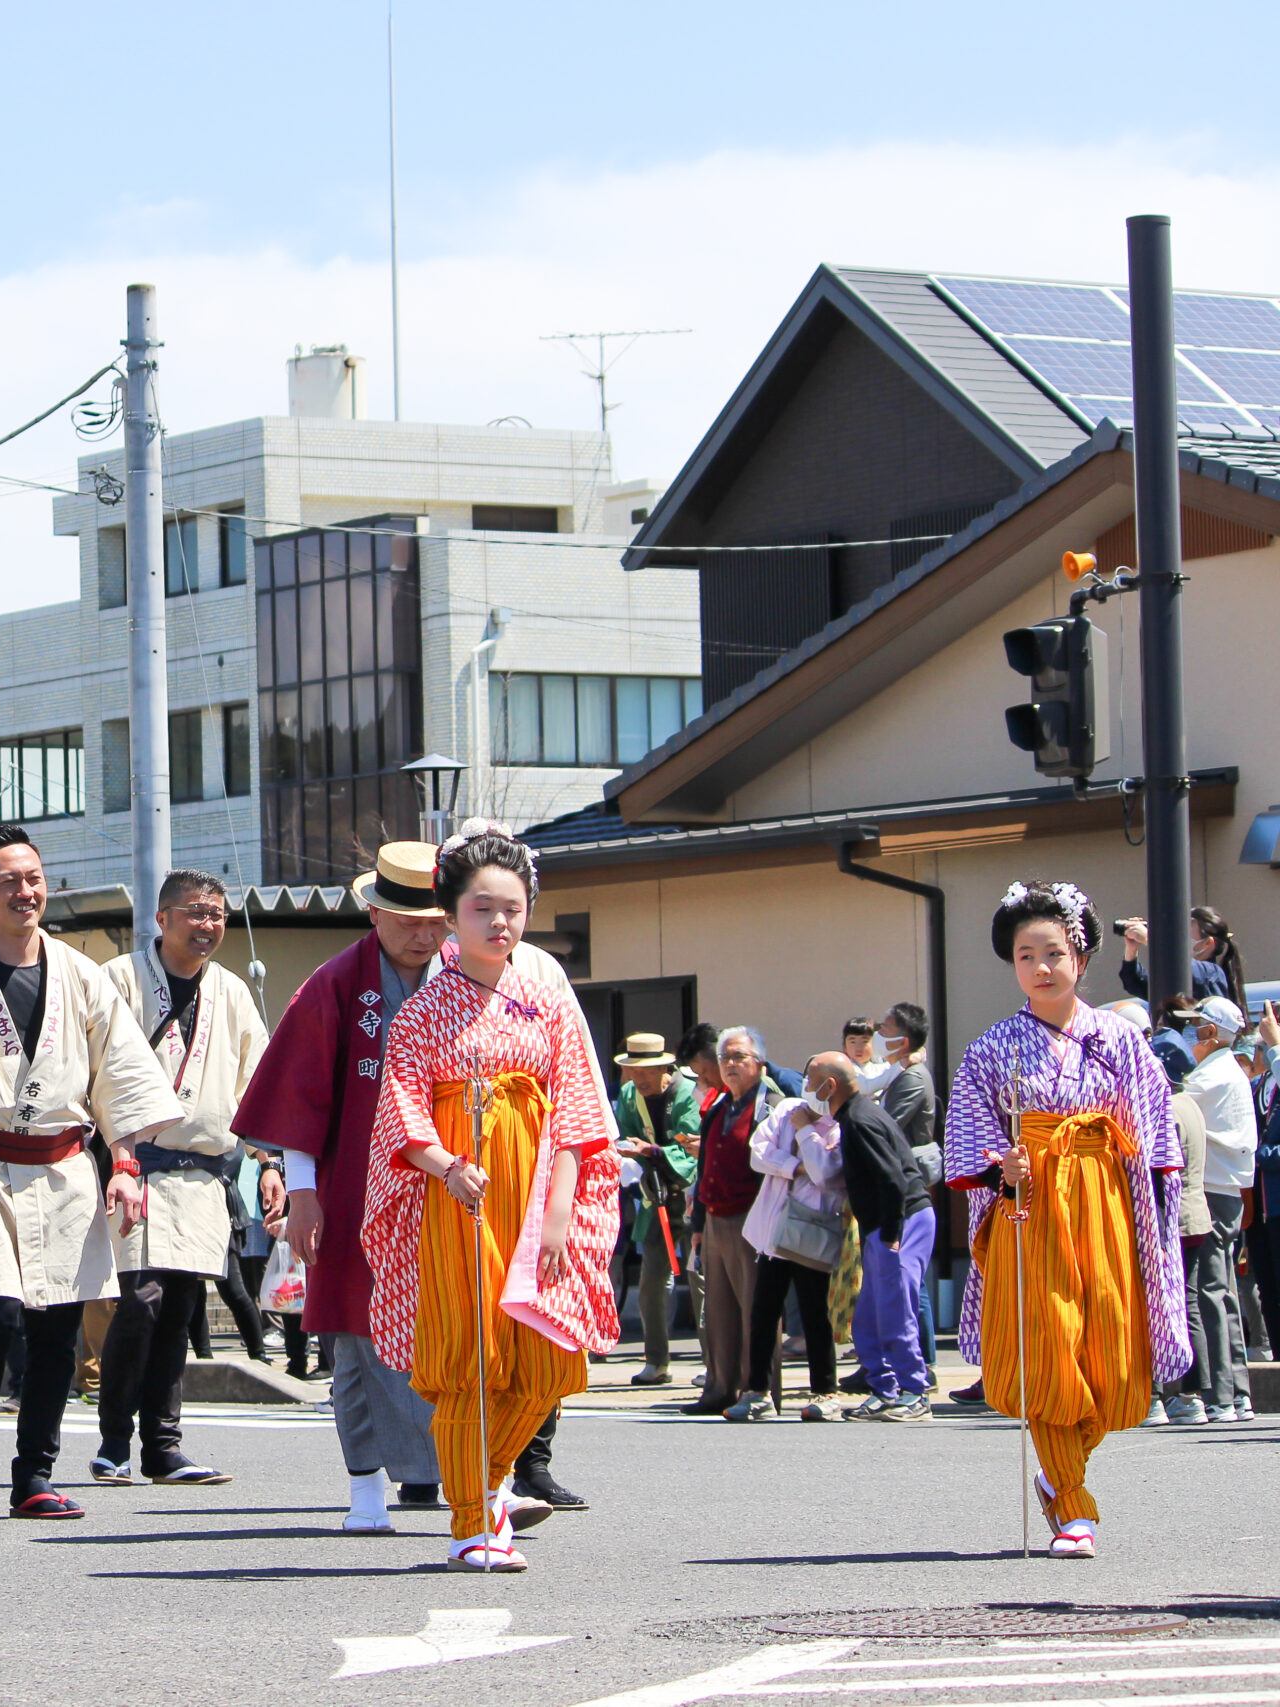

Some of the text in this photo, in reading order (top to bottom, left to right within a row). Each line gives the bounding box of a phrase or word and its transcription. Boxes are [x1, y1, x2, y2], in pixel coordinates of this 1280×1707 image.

[42, 976, 61, 1055] てらまち
[358, 1010, 381, 1080] 寺町
